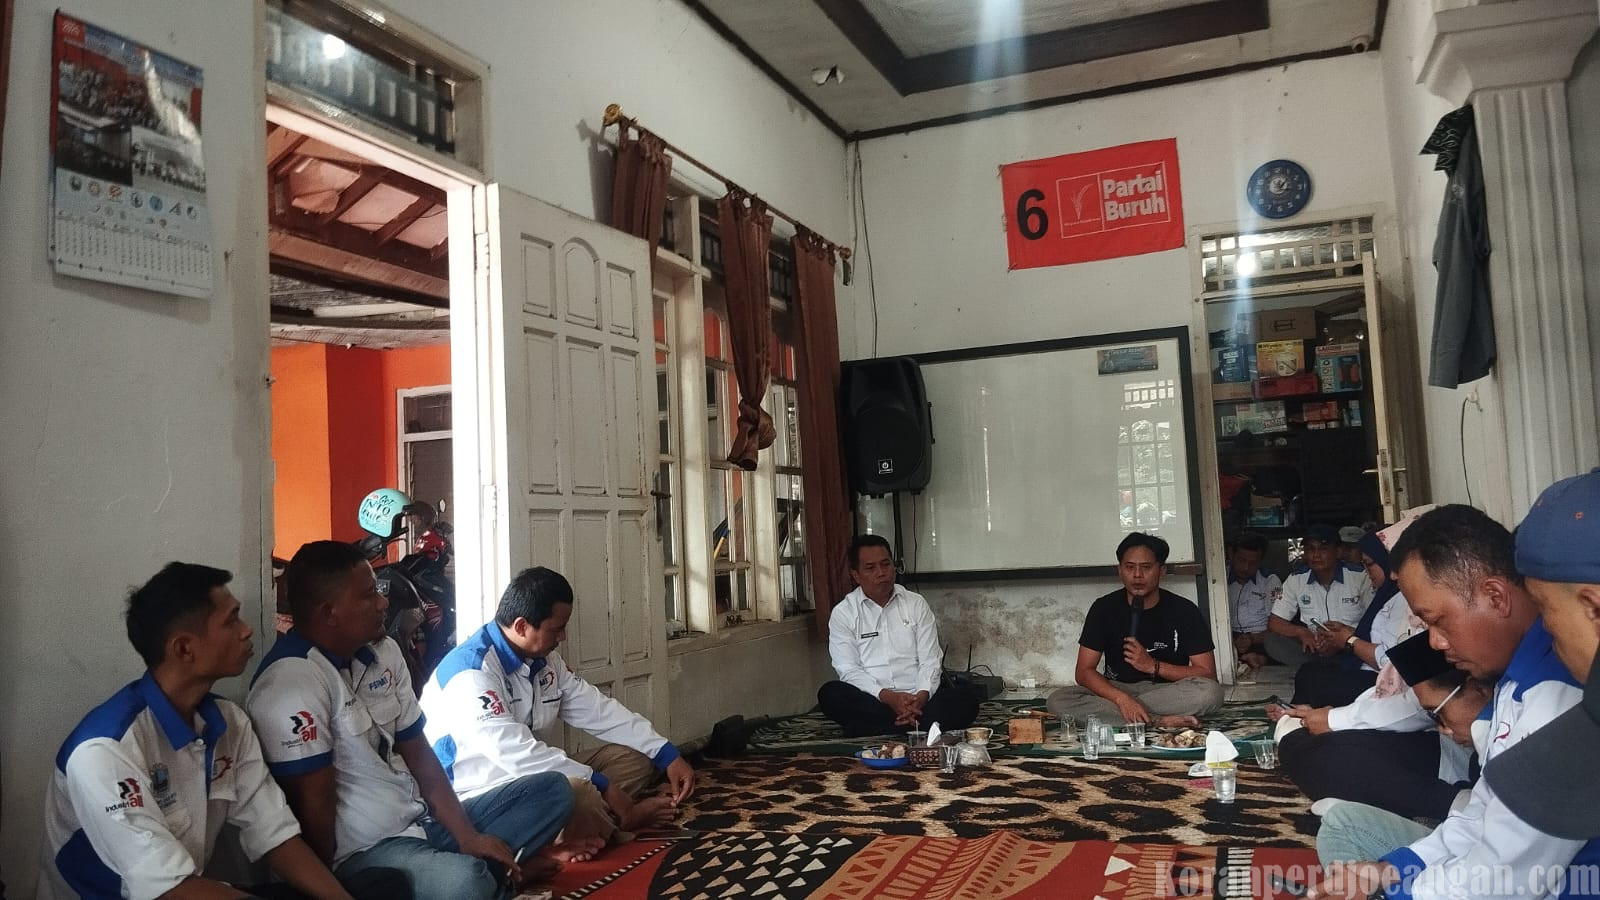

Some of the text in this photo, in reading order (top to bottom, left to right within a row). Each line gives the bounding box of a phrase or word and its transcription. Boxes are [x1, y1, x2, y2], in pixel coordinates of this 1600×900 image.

[1103, 170, 1163, 199] Partai
[1016, 189, 1048, 240] 6
[1106, 193, 1165, 221] Buruh
